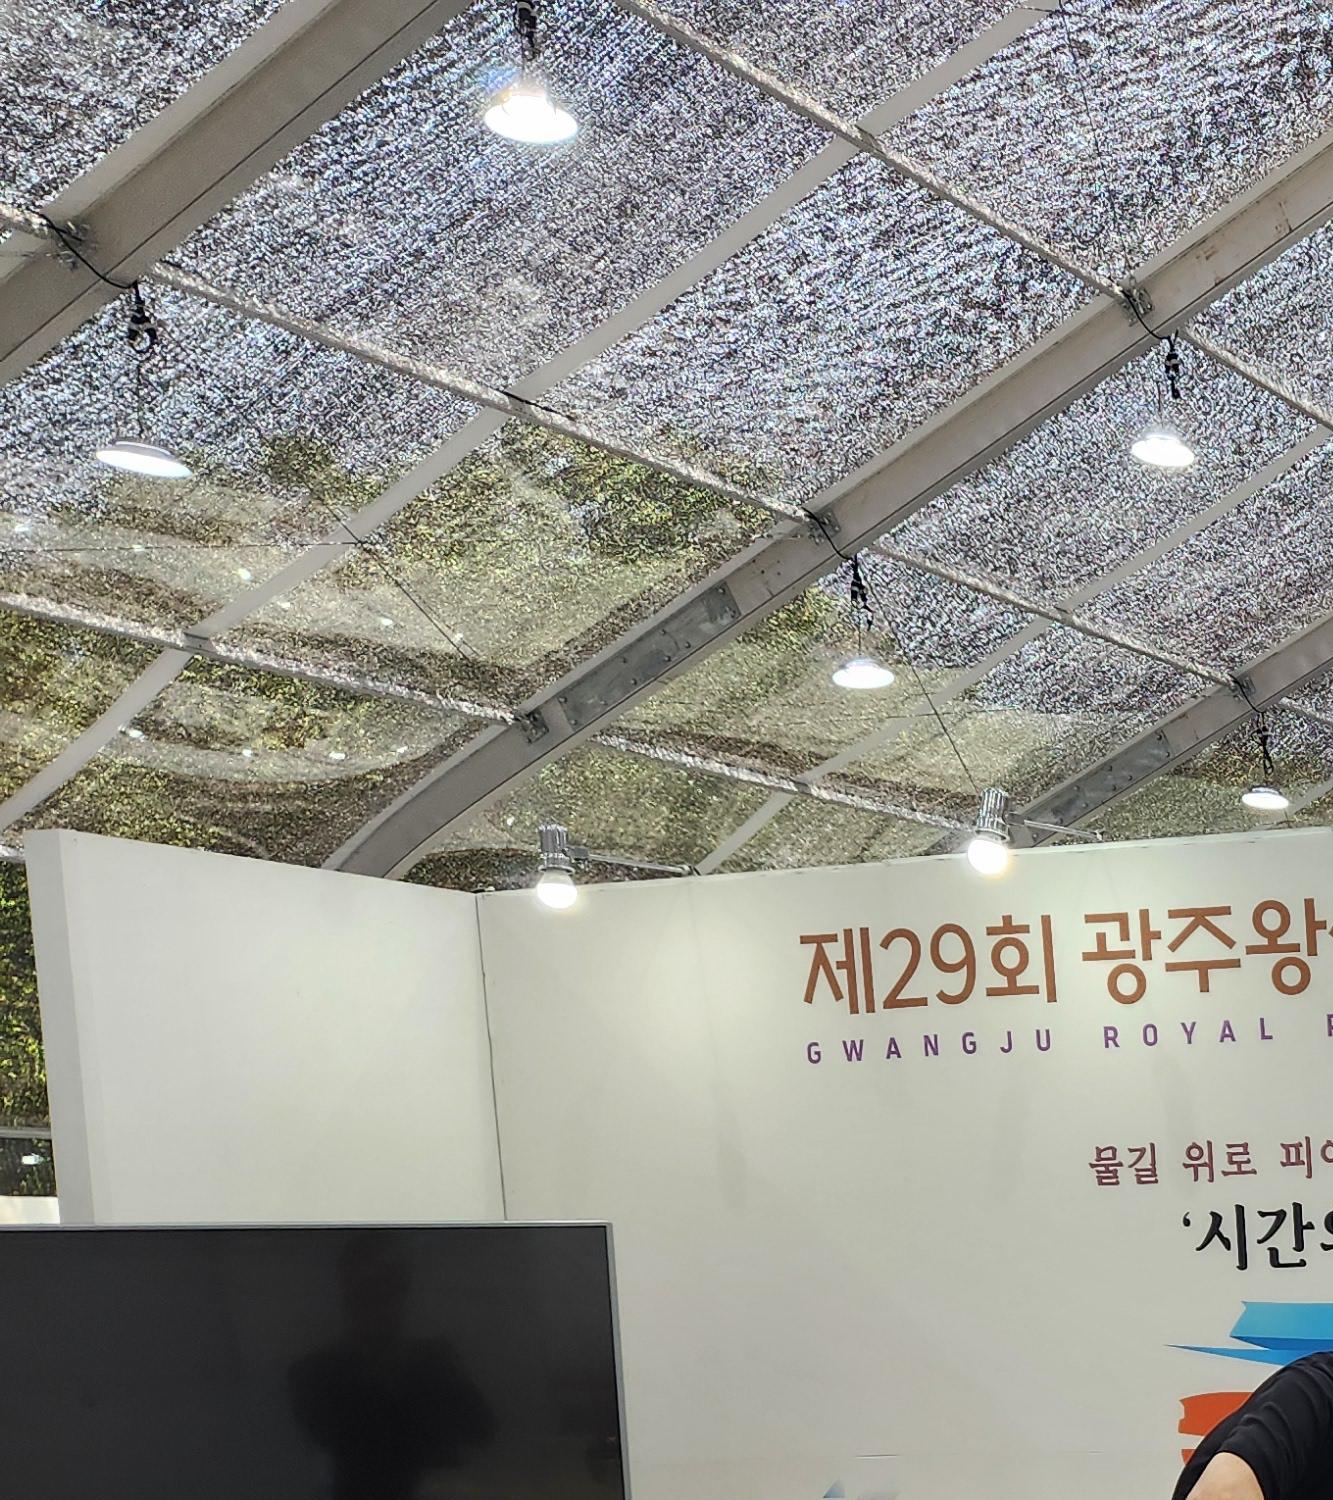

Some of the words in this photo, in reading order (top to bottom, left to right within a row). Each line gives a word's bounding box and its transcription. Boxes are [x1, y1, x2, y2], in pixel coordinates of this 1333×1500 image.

[799, 914, 1058, 1015] 제29회
[806, 1028, 1052, 1065] GWANGJU
[1103, 1017, 1274, 1049] ROYAL
[1088, 1142, 1160, 1187] 물길
[1181, 1139, 1258, 1183] 위로
